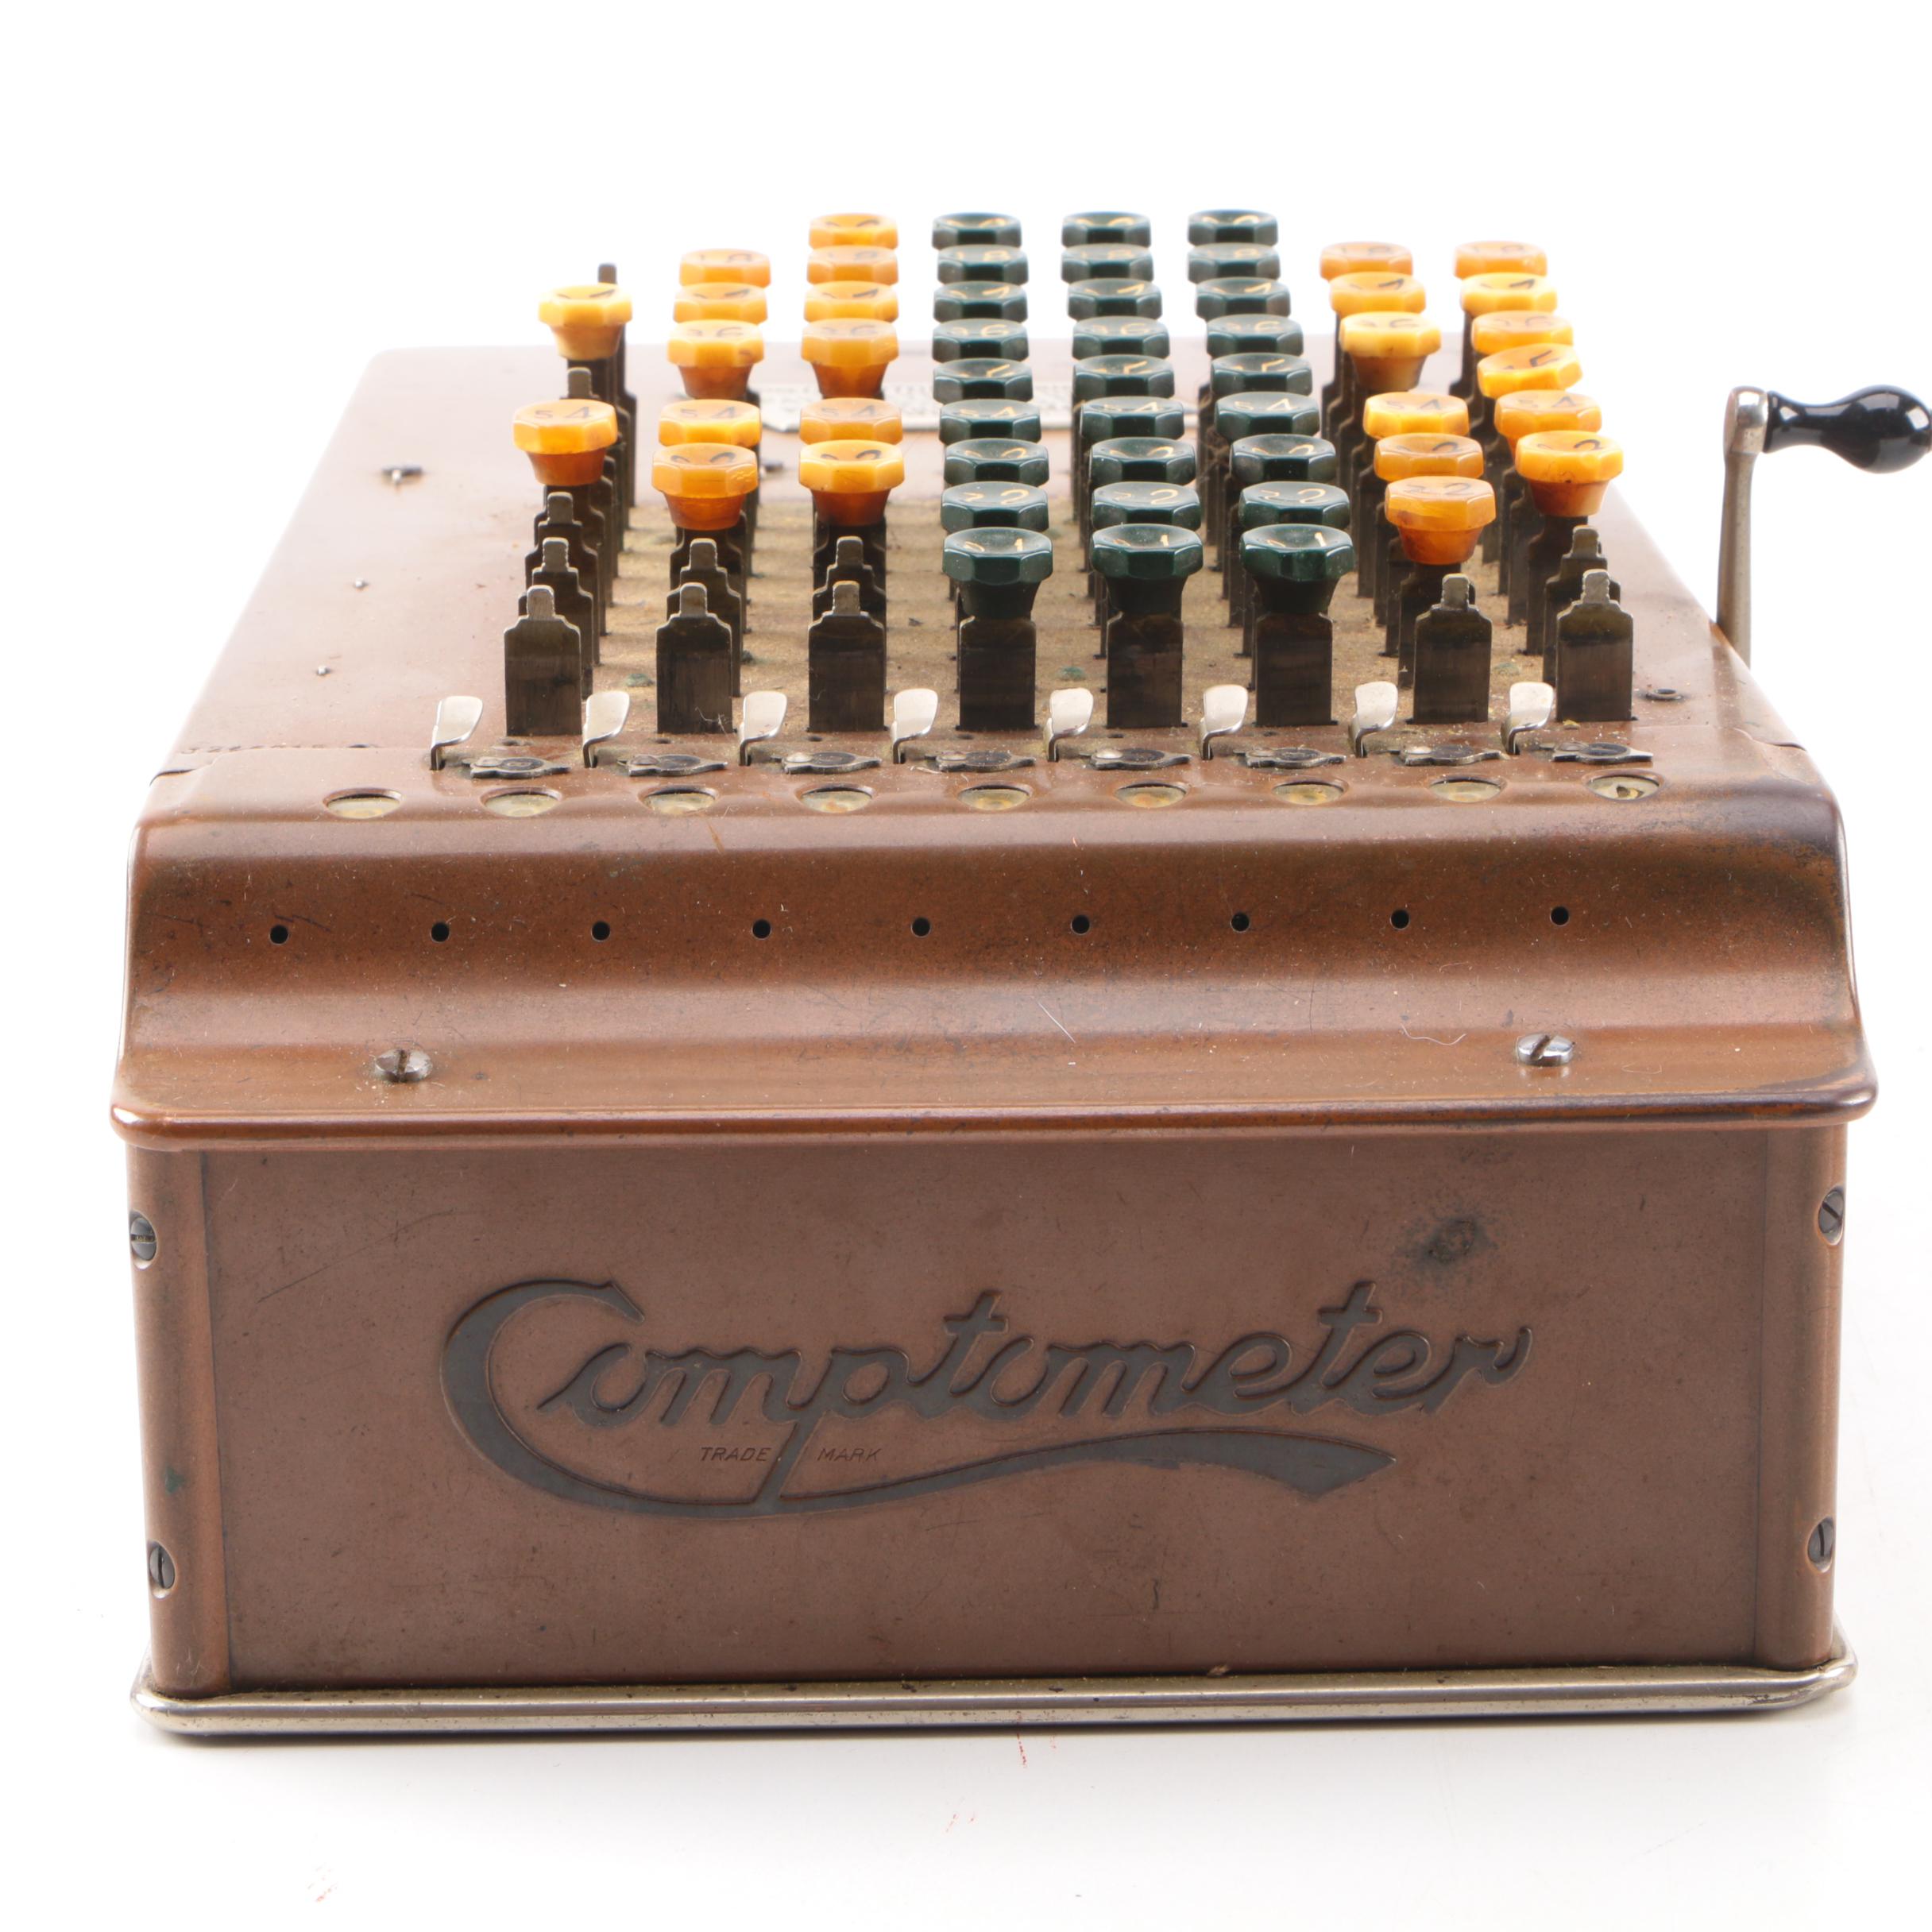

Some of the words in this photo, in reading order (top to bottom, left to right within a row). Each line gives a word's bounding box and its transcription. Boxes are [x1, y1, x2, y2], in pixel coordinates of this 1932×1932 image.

[1000, 489, 1030, 506] 2
[1150, 489, 1180, 505] 2
[1298, 488, 1330, 504] 2
[439, 1279, 1535, 1519] Comptometer
[699, 1446, 772, 1463] TRADE
[816, 1446, 883, 1463] MARK
